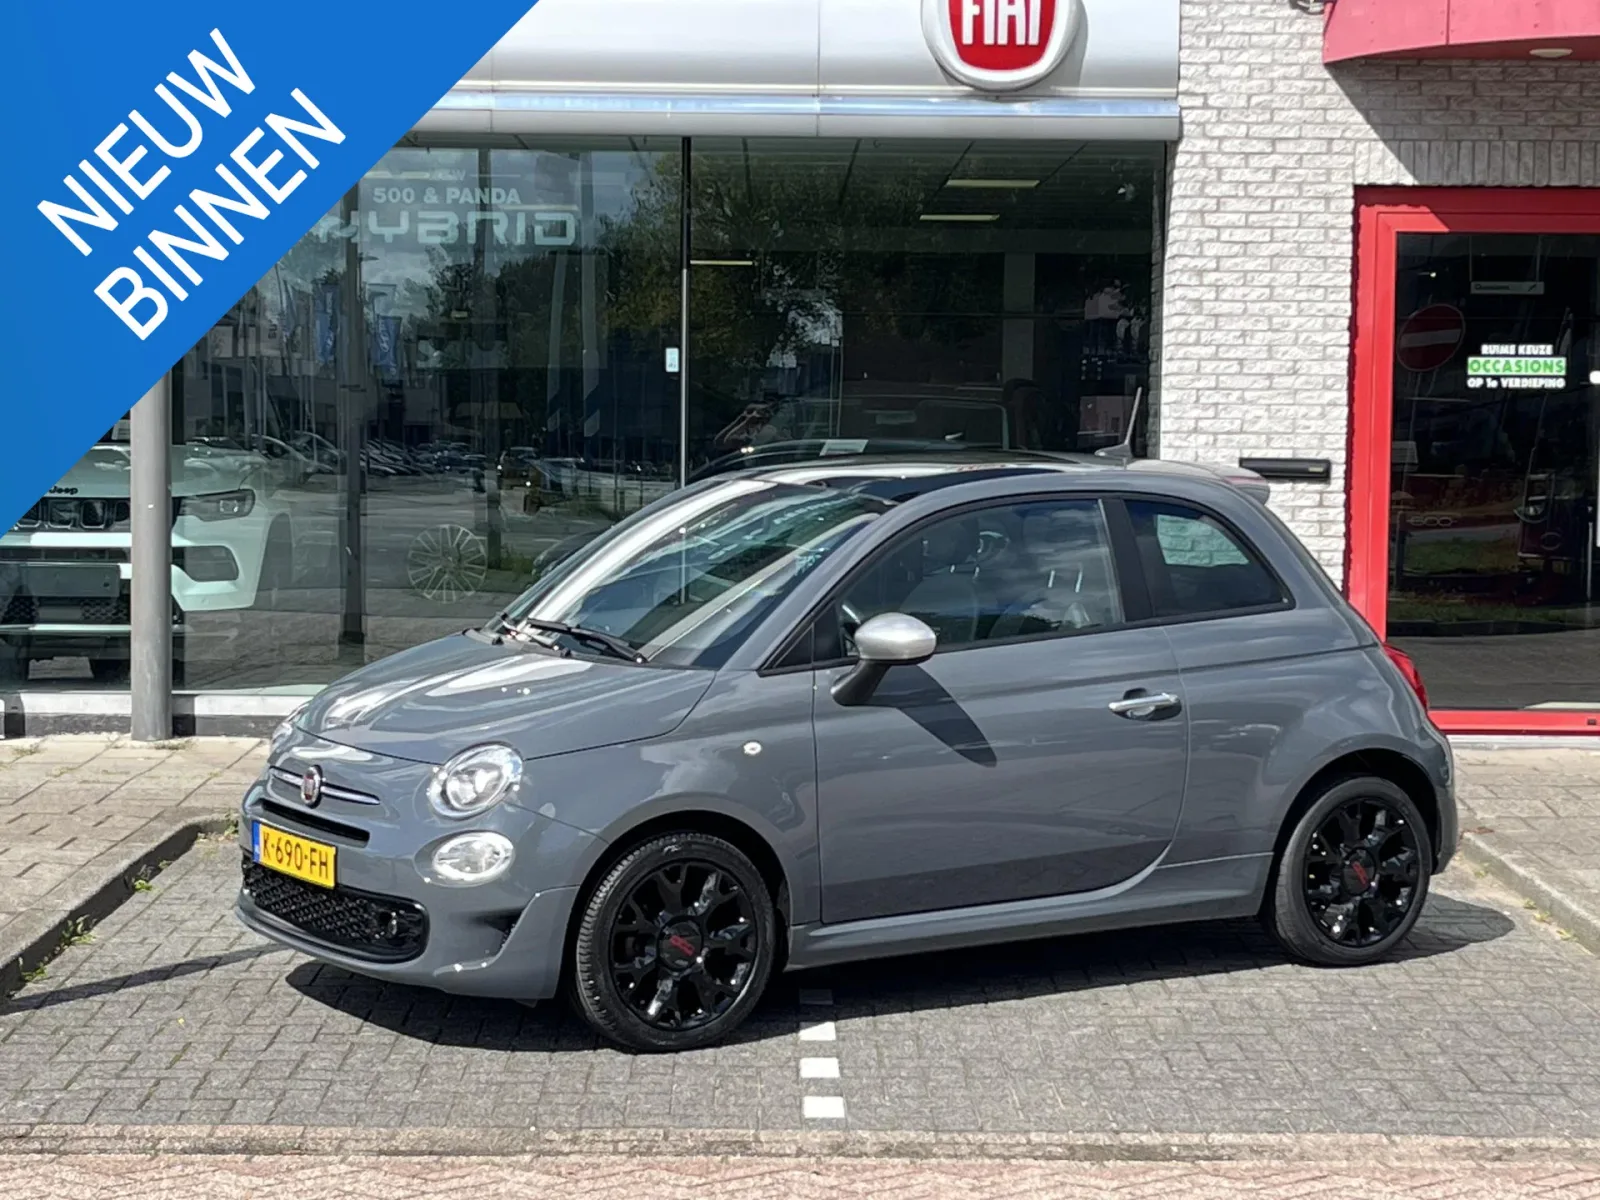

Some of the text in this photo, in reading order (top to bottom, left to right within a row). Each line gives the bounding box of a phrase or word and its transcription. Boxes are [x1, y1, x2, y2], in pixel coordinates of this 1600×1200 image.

[373, 187, 522, 205] 500 & PANDA
[1481, 344, 1553, 355] RUIME KEUZE
[1469, 360, 1564, 373] OCCASIONS
[1467, 378, 1484, 388] OP
[1500, 377, 1566, 388] VERDIEPING
[48, 486, 78, 495] Jeep
[263, 832, 328, 880] K-690-FH
